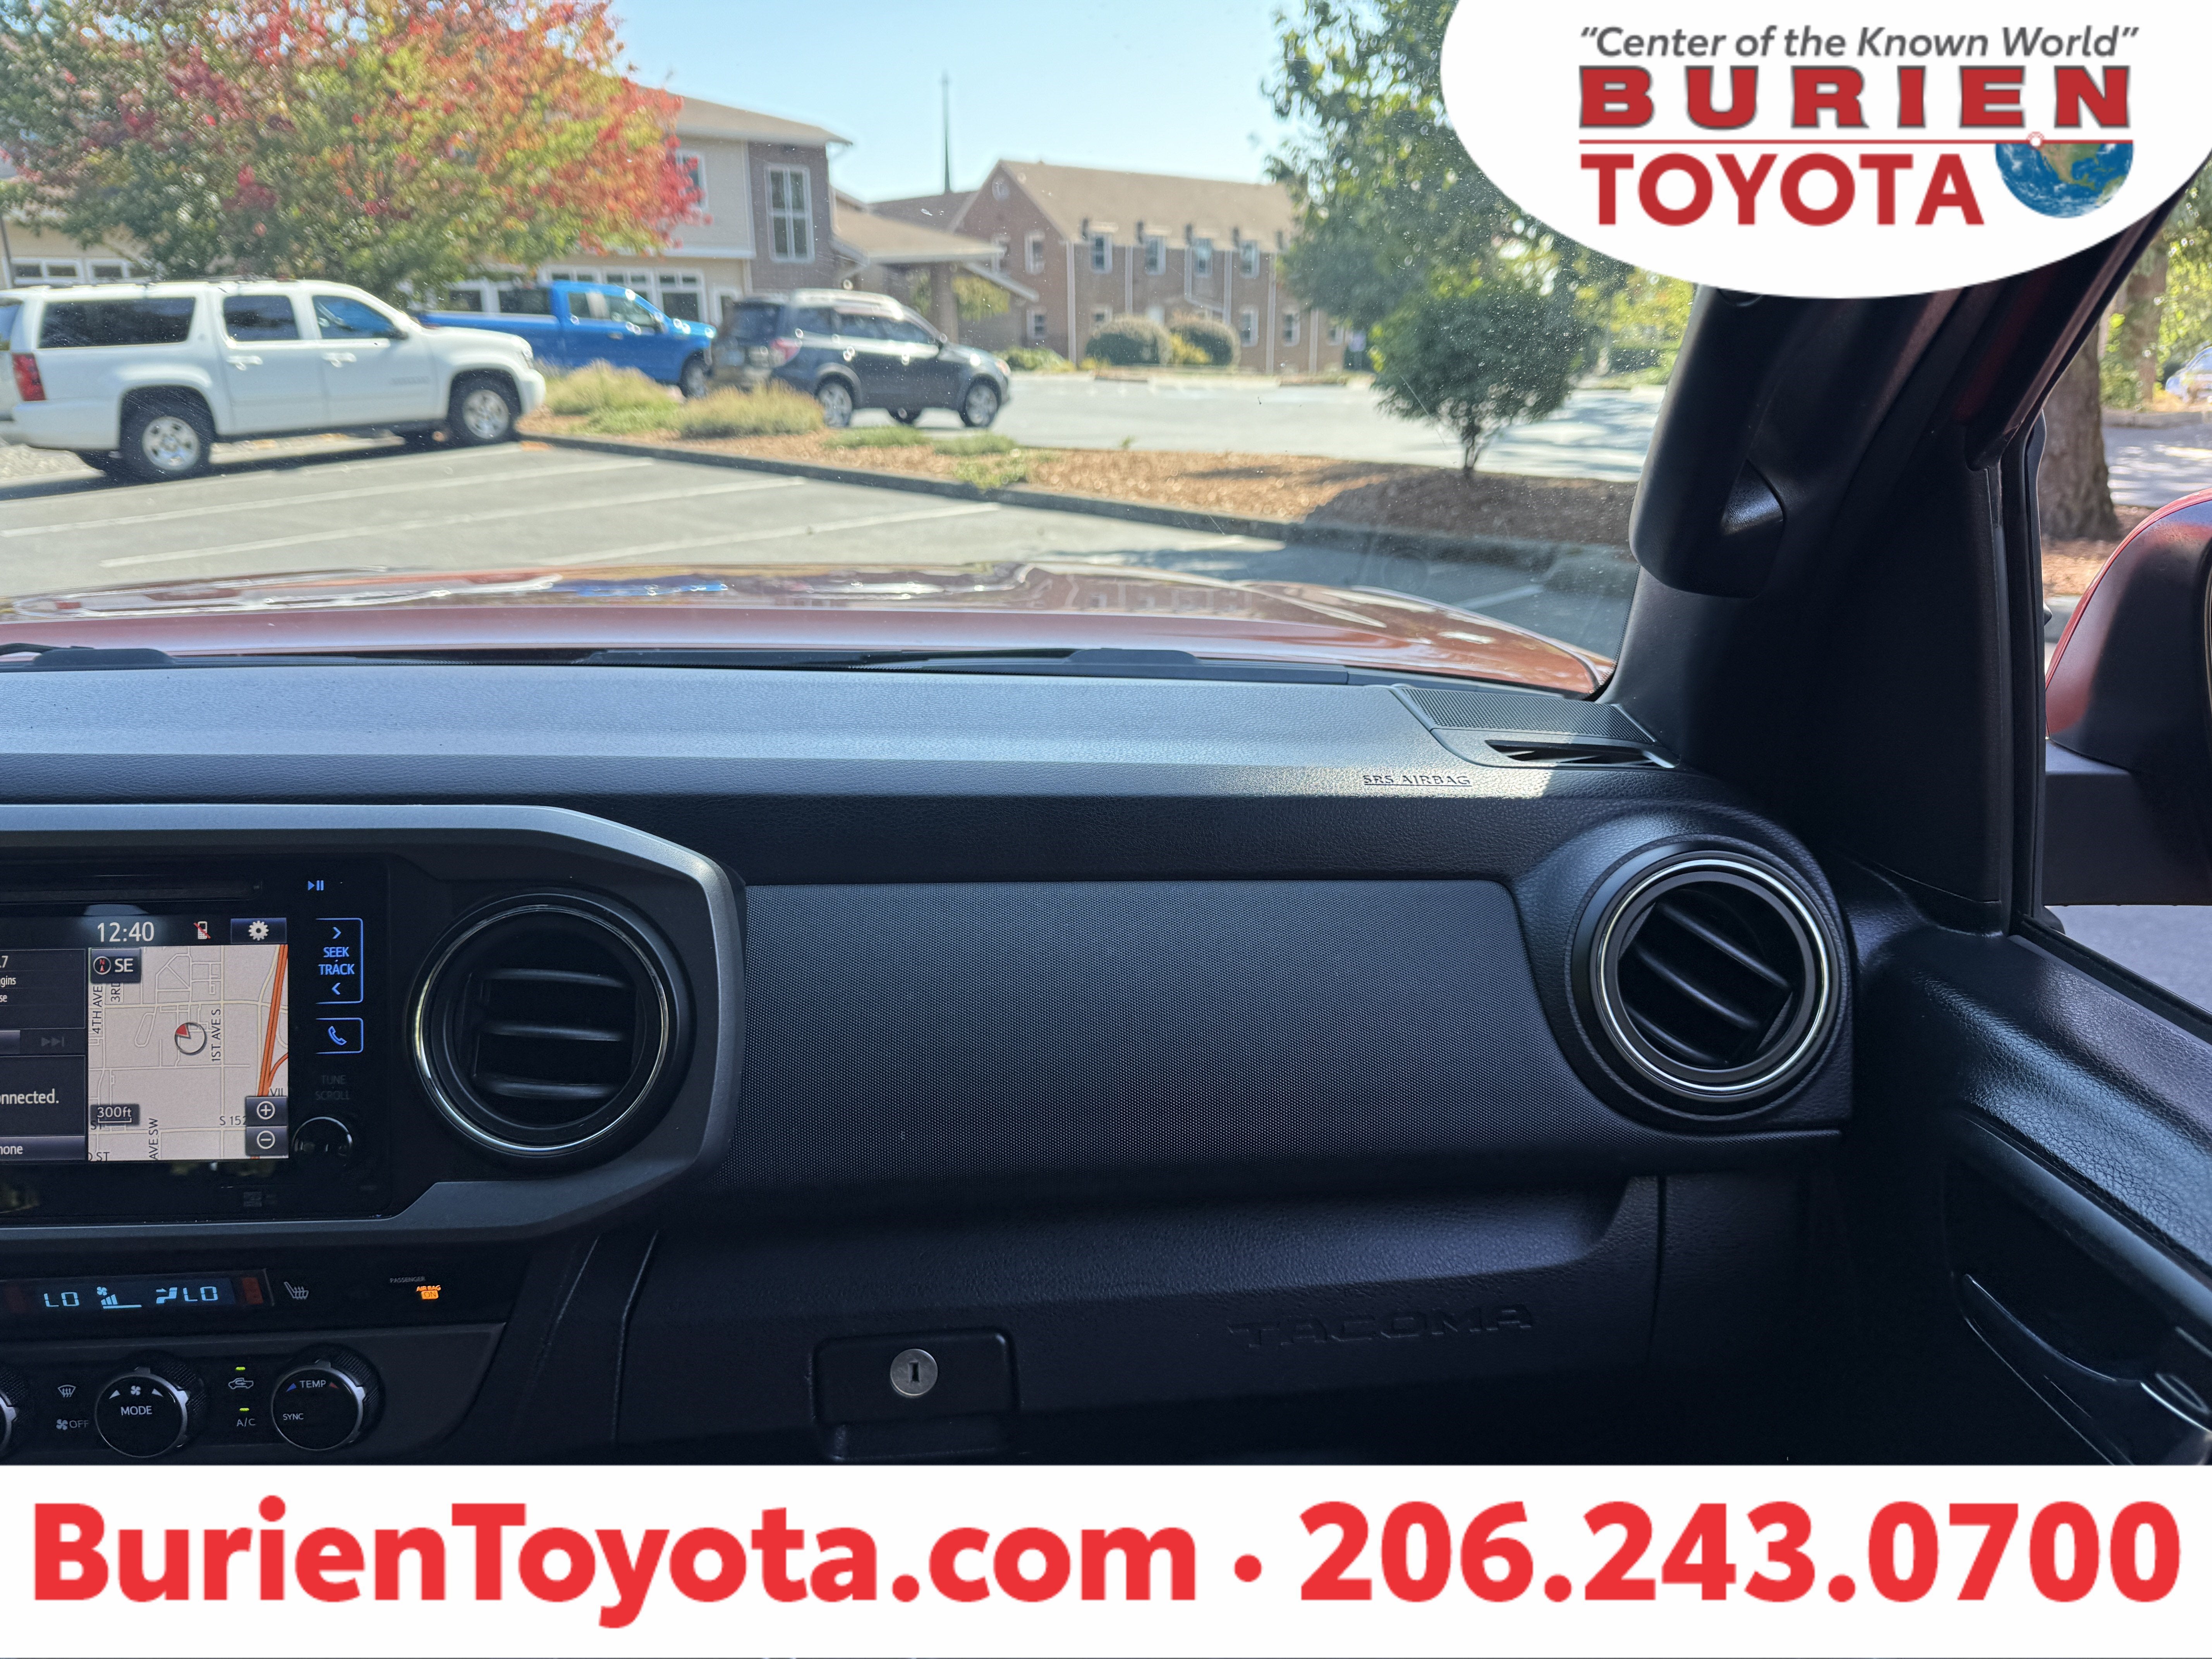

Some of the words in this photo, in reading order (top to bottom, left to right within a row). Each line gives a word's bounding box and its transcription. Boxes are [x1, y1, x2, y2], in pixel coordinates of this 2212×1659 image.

[1362, 775, 1394, 784] SRS
[1402, 775, 1470, 785] AIRBAG
[97, 922, 155, 942] 12:40
[323, 946, 349, 958] SEEK
[115, 958, 134, 972] SE
[318, 963, 355, 975] TRACK
[0, 975, 16, 988] gins
[93, 986, 103, 1007] AVE
[92, 1011, 102, 1034] 4TH
[211, 1018, 221, 1040] AVE
[211, 1043, 221, 1062] 1ST
[321, 1075, 346, 1085] TUNE
[0, 1088, 59, 1104] nnected.
[315, 1090, 350, 1101] SCROLL
[97, 1106, 132, 1118] 300ft
[148, 1118, 158, 1135] SW
[219, 1115, 226, 1126] S
[148, 1138, 158, 1161] AVE
[96, 1152, 110, 1161] ST
[1227, 1303, 1536, 1348] TACOMA
[299, 1380, 326, 1388] TEMP
[120, 1405, 153, 1416] MODE
[69, 1419, 89, 1429] OFF
[236, 1418, 256, 1427] A/C
